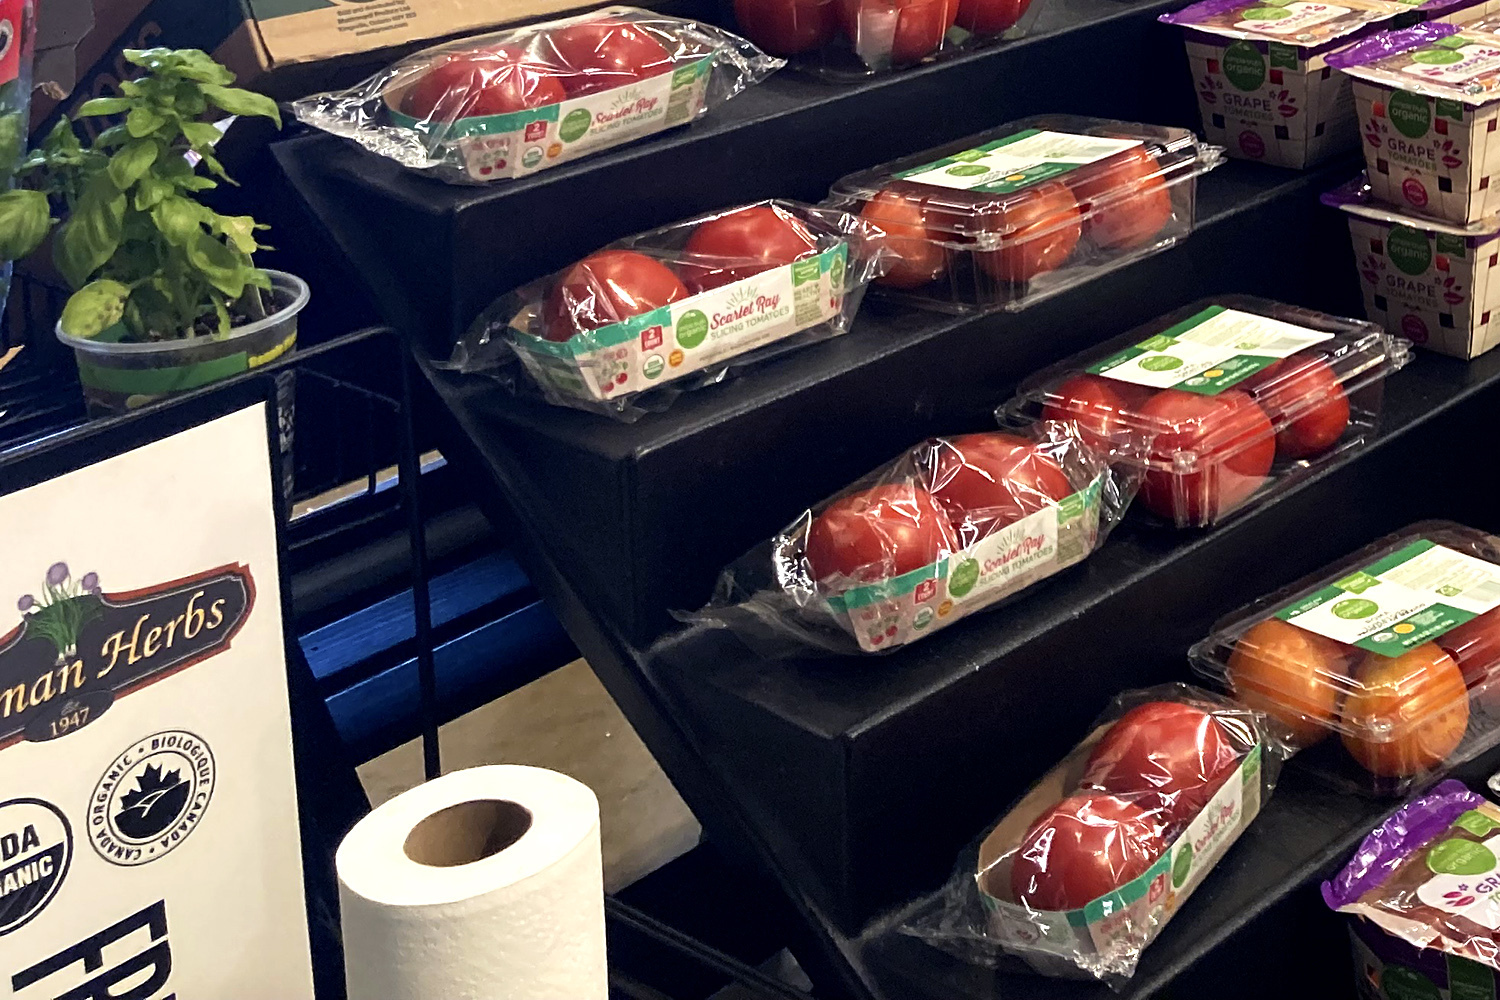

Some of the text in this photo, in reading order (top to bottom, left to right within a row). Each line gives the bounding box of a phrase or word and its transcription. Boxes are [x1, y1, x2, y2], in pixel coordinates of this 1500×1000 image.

[1226, 62, 1264, 78] organic
[591, 95, 659, 128] Scarlet Ray
[1222, 92, 1272, 112] GRAPE
[1222, 105, 1275, 122] TOMATOES
[532, 122, 541, 133] 2
[1390, 108, 1429, 125] organic
[1387, 137, 1436, 161] GRAPE
[1387, 151, 1438, 172] TOMATOES
[1386, 272, 1437, 297] GRAPE
[710, 302, 754, 330] Scarlet
[755, 293, 780, 314] Ray
[710, 306, 790, 342] SLICING TOMATOES
[647, 328, 656, 339] 2
[981, 533, 1046, 577] Scarlet Ray
[1010, 544, 1054, 572] TOMATOES
[922, 580, 930, 591] 2
[97, 590, 226, 679] Herbs
[50, 707, 90, 737] 1947
[150, 735, 211, 850] BIOLOGIQUE CANADA
[92, 754, 142, 861] CANADA ORGANIC
[0, 823, 41, 861] DA
[0, 854, 54, 898] ANIC
